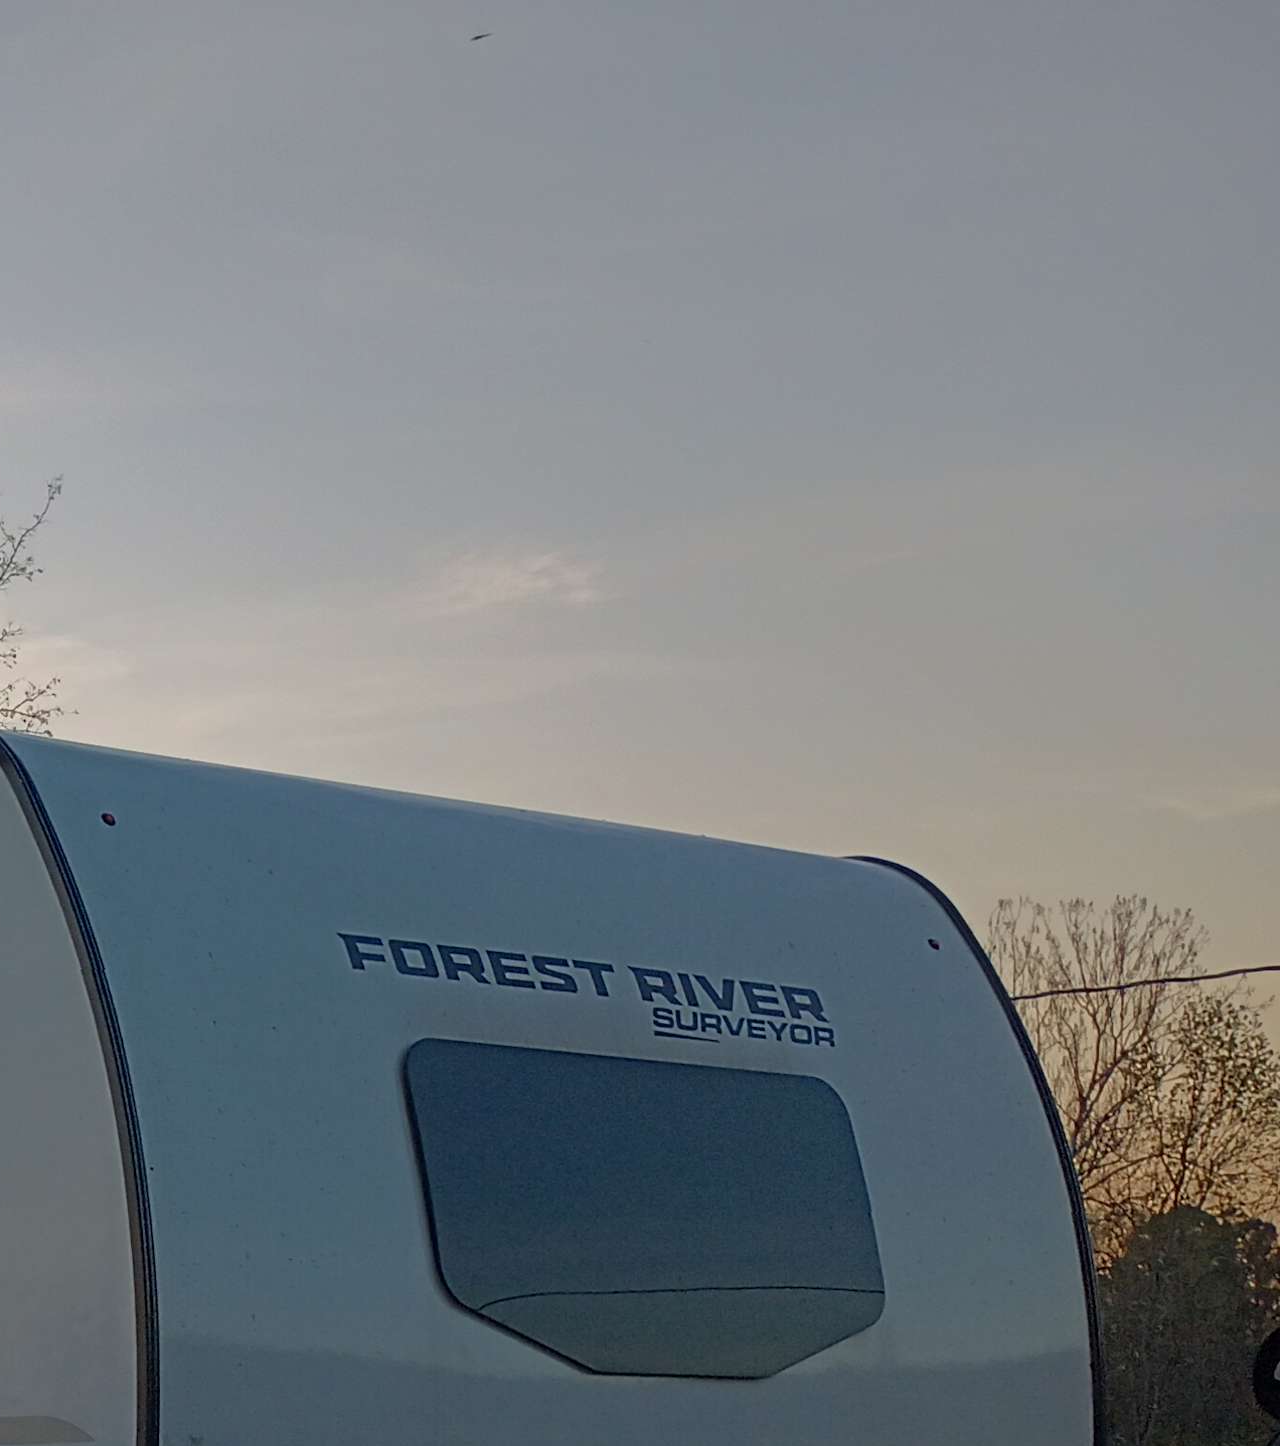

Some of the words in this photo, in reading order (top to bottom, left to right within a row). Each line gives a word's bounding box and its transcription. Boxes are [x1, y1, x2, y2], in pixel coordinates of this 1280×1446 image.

[336, 932, 614, 998] FOREST
[627, 965, 830, 1023] RIVER
[652, 1007, 836, 1048] SURVEYOR
